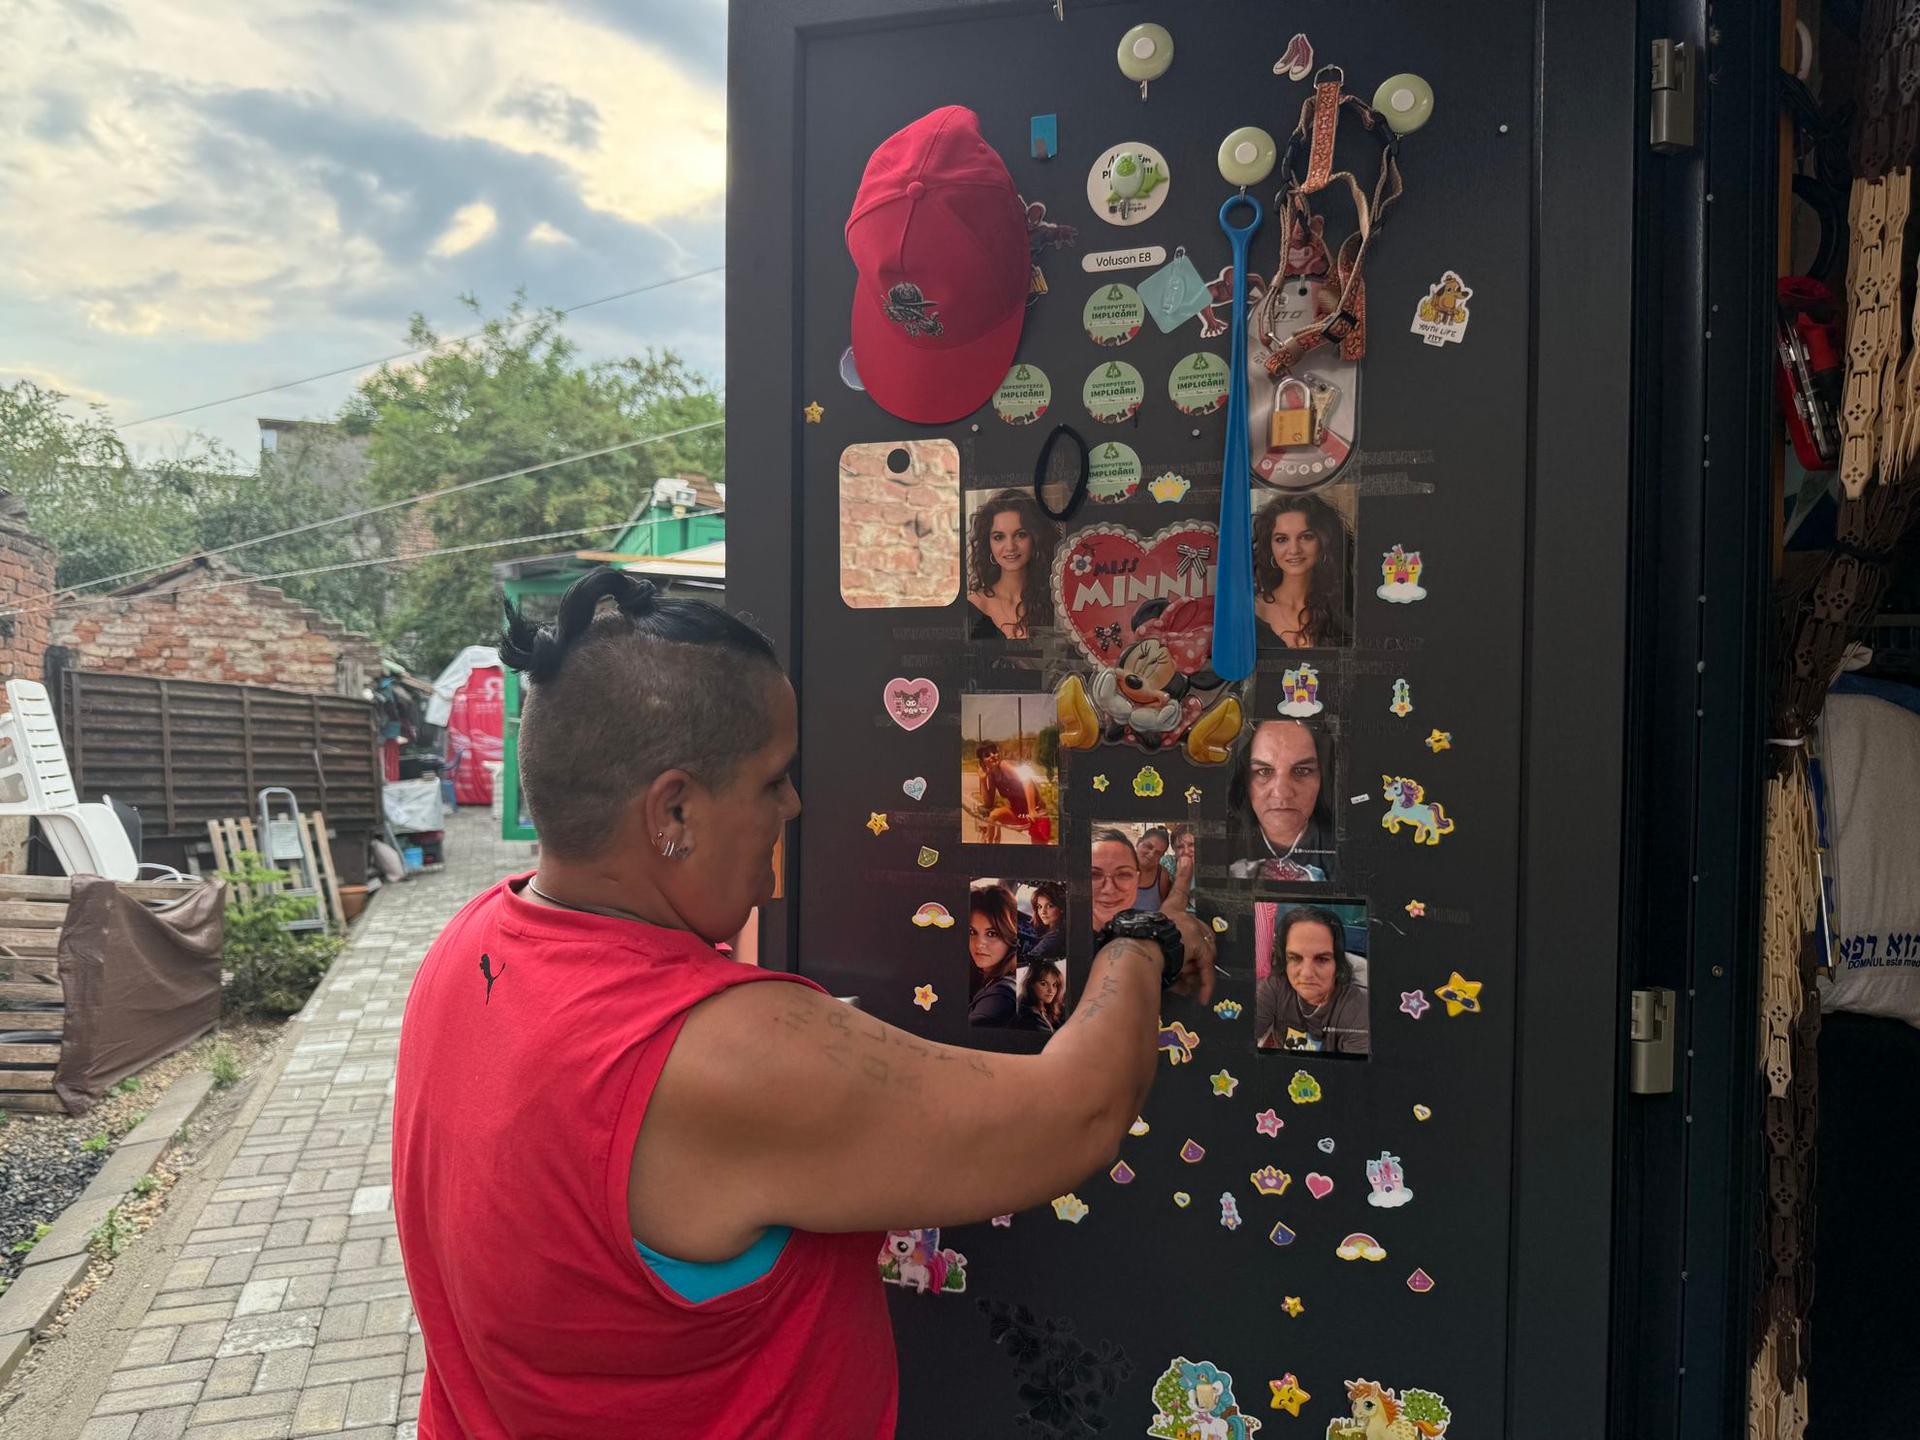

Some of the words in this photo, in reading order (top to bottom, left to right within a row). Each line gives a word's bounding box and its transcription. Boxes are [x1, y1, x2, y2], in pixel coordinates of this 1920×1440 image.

[1096, 253, 1136, 267] Voluson
[1138, 252, 1152, 263] E8
[1092, 309, 1138, 320] IMPLICĂRII
[1177, 379, 1225, 390] IMPLICĂRII
[1000, 389, 1045, 399] IMPLICĂRII
[1090, 386, 1136, 398] IMPLICĂRII
[1093, 557, 1139, 576] MISS
[1847, 958, 1884, 970] DOMNUL
[1886, 956, 1903, 967] este
